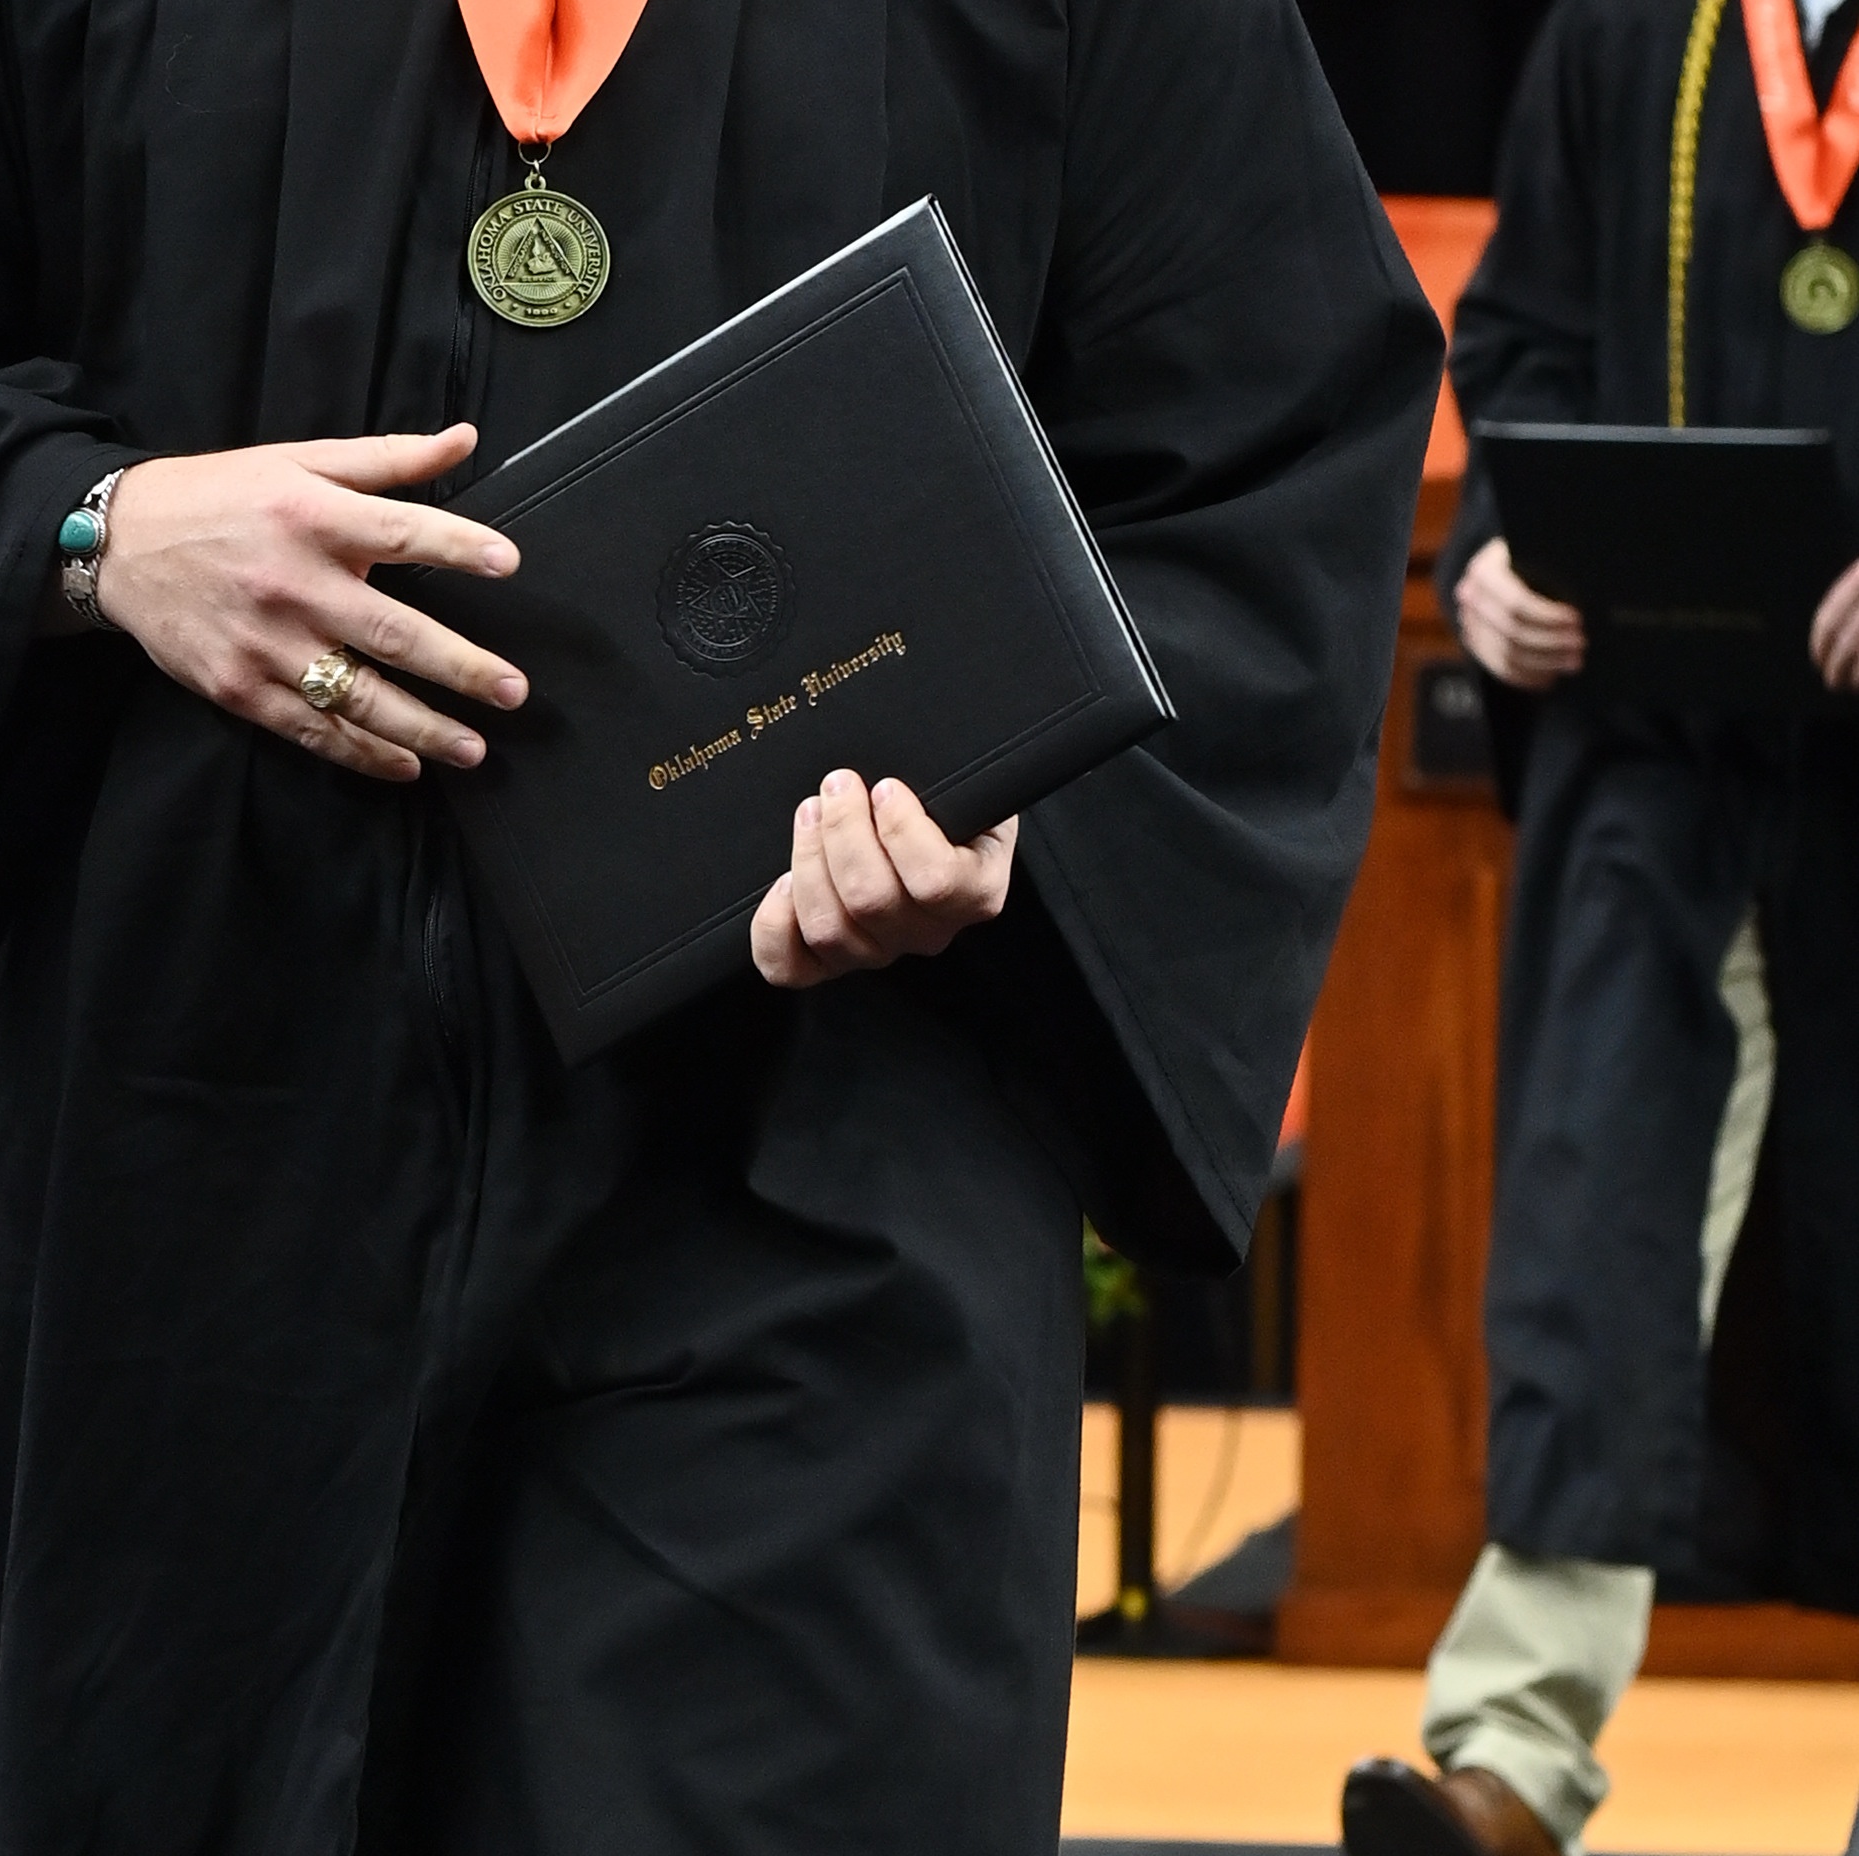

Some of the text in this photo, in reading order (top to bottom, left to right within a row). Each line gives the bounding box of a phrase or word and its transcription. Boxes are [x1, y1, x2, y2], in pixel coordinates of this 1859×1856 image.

[478, 211, 513, 301] OKLAHOMA
[513, 198, 563, 215] STATE
[567, 209, 601, 301] UNIVERSITY
[648, 631, 907, 790] Oklahoma State University
